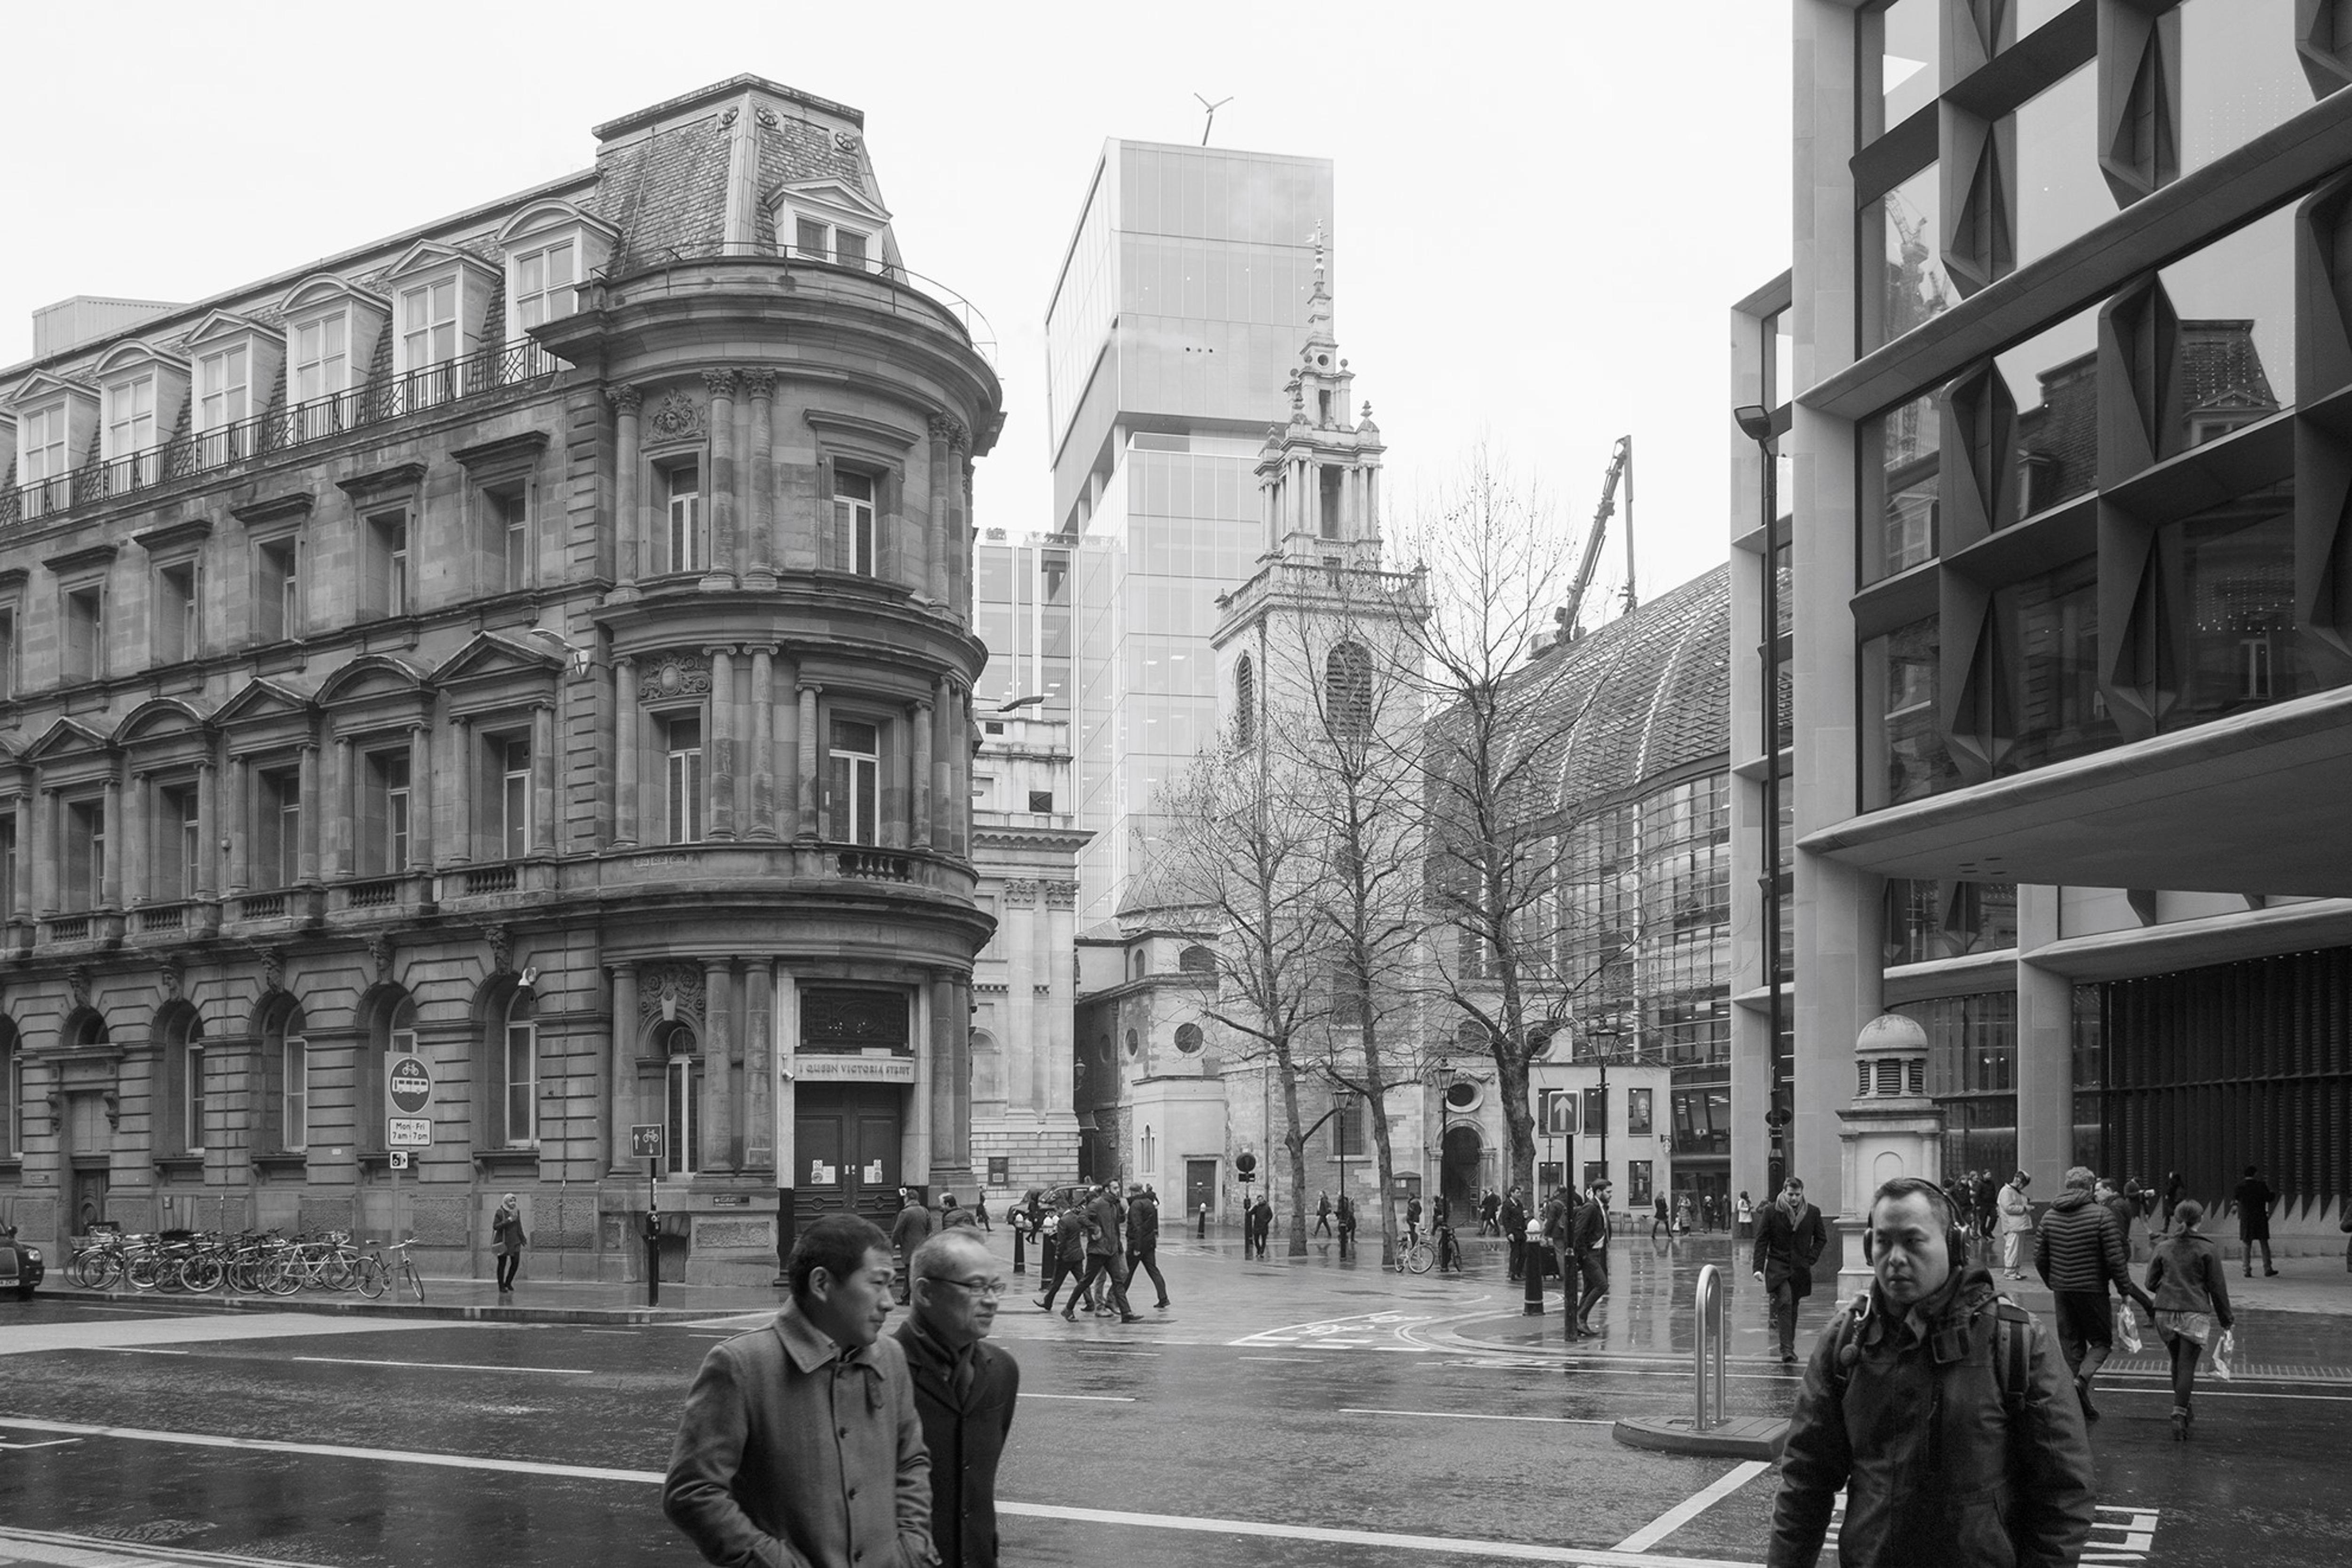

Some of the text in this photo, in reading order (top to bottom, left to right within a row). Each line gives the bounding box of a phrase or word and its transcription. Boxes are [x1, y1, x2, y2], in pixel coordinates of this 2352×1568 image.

[806, 1064, 838, 1073] QUEEN
[841, 1064, 883, 1074] VICTORIA
[886, 1065, 911, 1075] STREET
